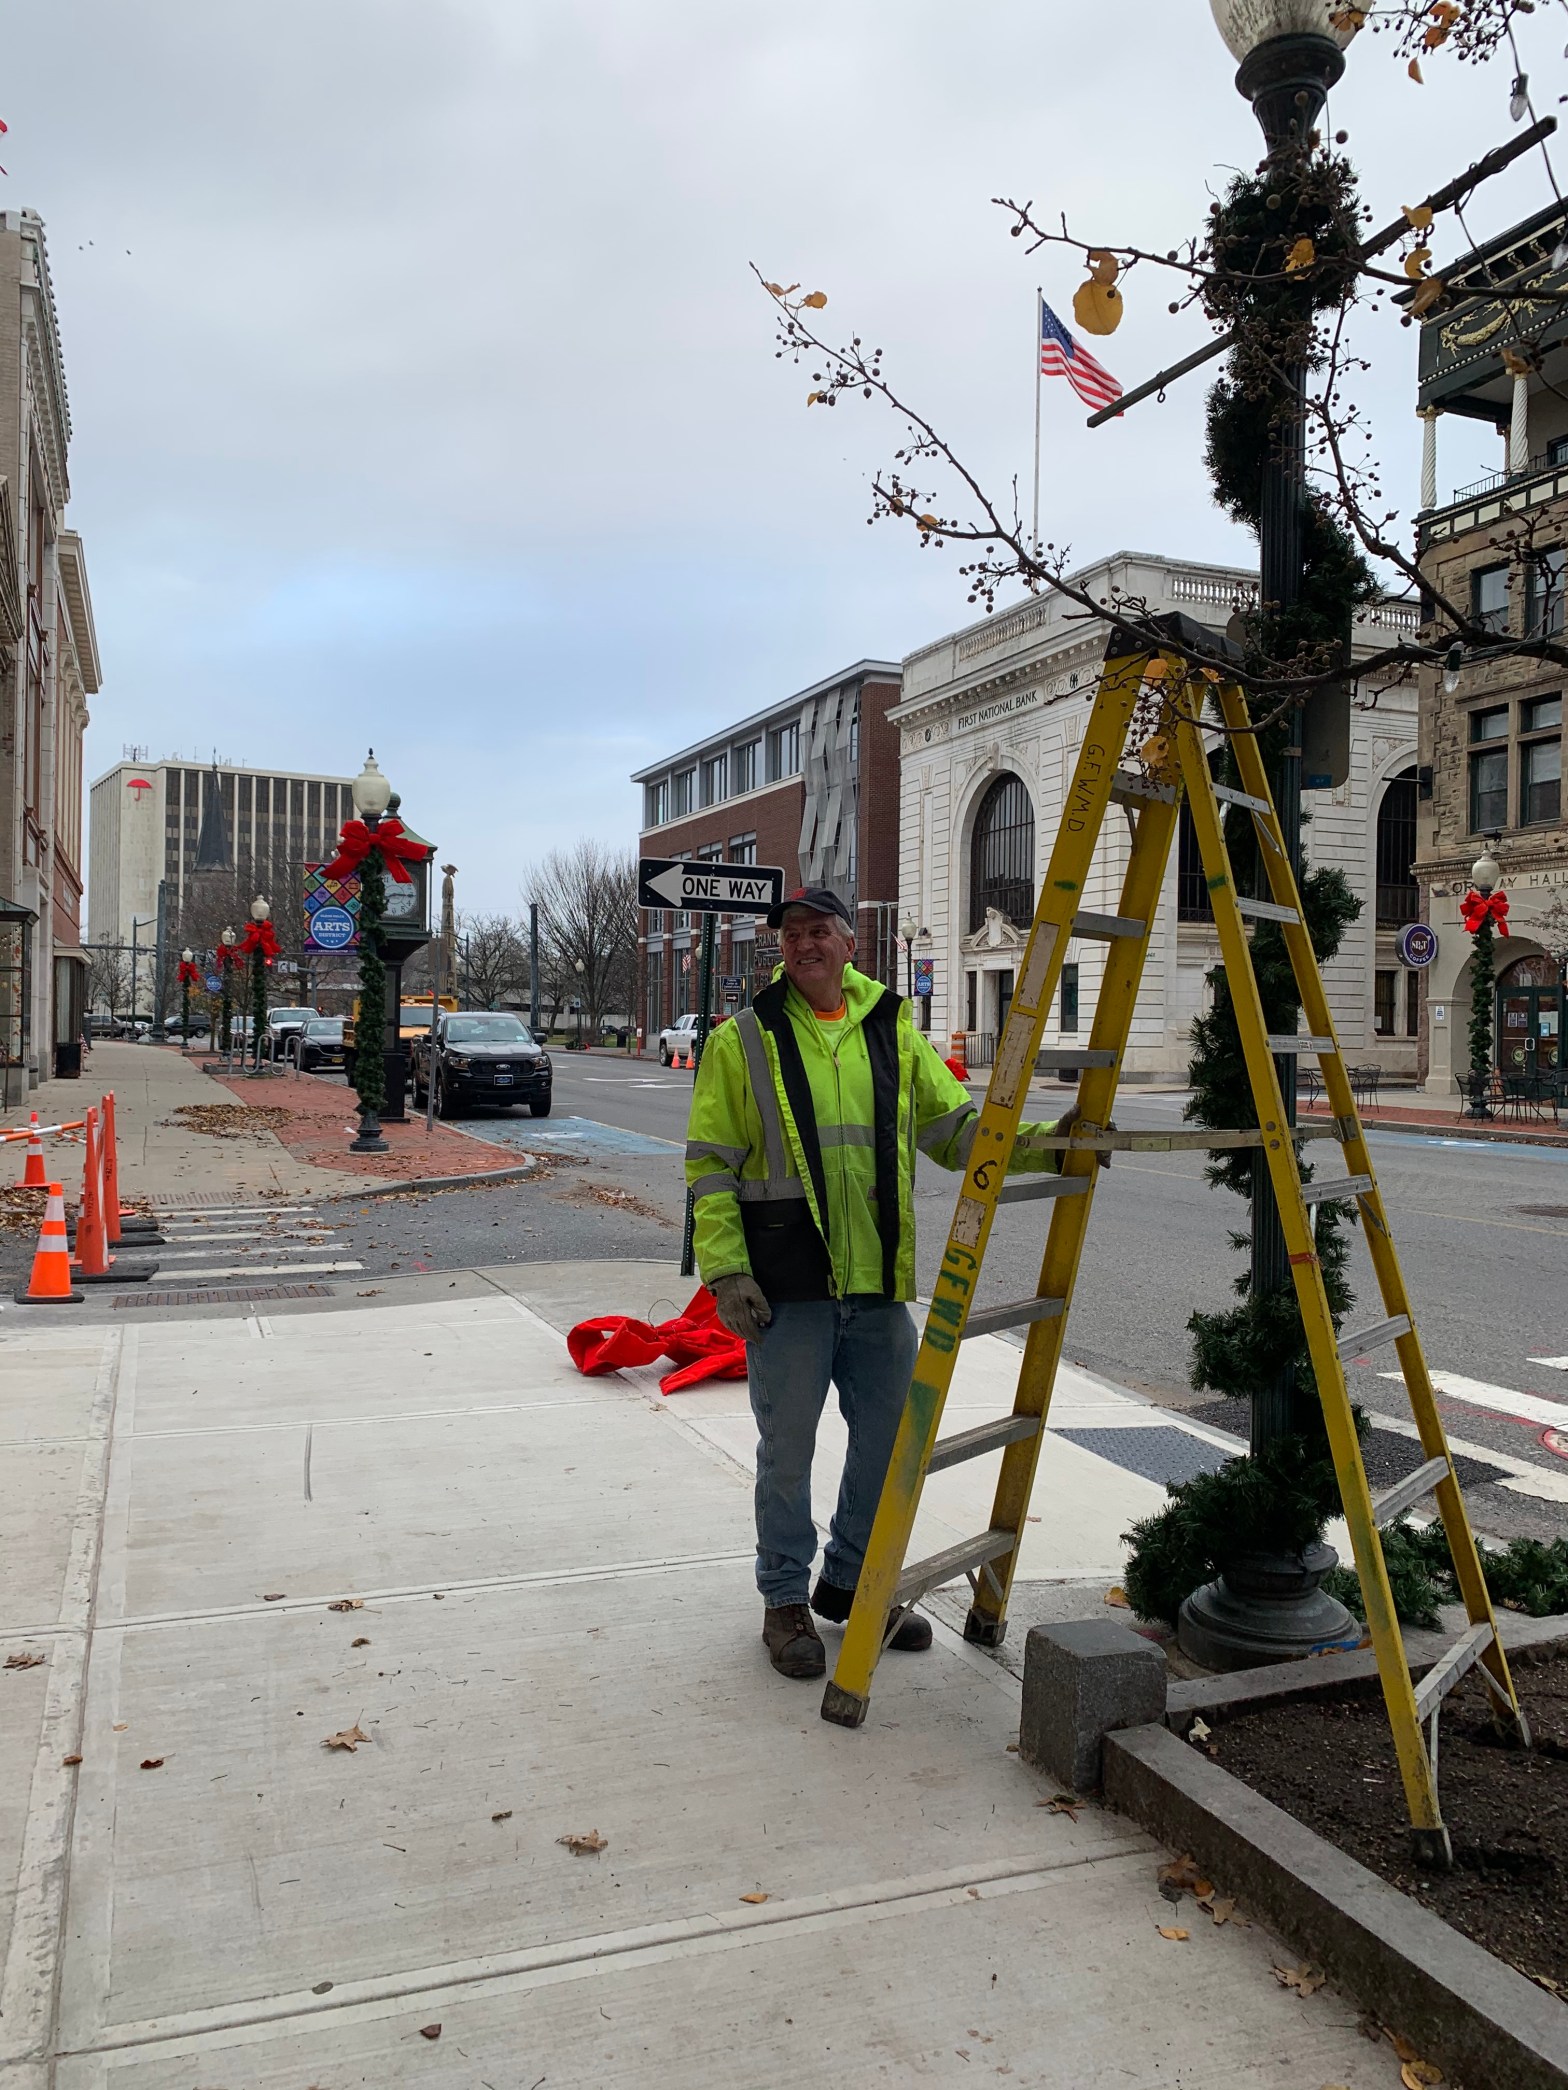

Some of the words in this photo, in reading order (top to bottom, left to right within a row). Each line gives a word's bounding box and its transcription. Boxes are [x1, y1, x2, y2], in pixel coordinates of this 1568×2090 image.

[958, 713, 979, 730] FIRST
[978, 698, 1015, 721] NATIONAL
[1015, 690, 1037, 709] BANK
[682, 876, 721, 898] ONE
[728, 879, 768, 900] WAY
[1452, 877, 1518, 894] ORAY
[1529, 871, 1568, 886] HALL
[313, 921, 351, 932] ARTS
[1409, 953, 1430, 962] COFFEE
